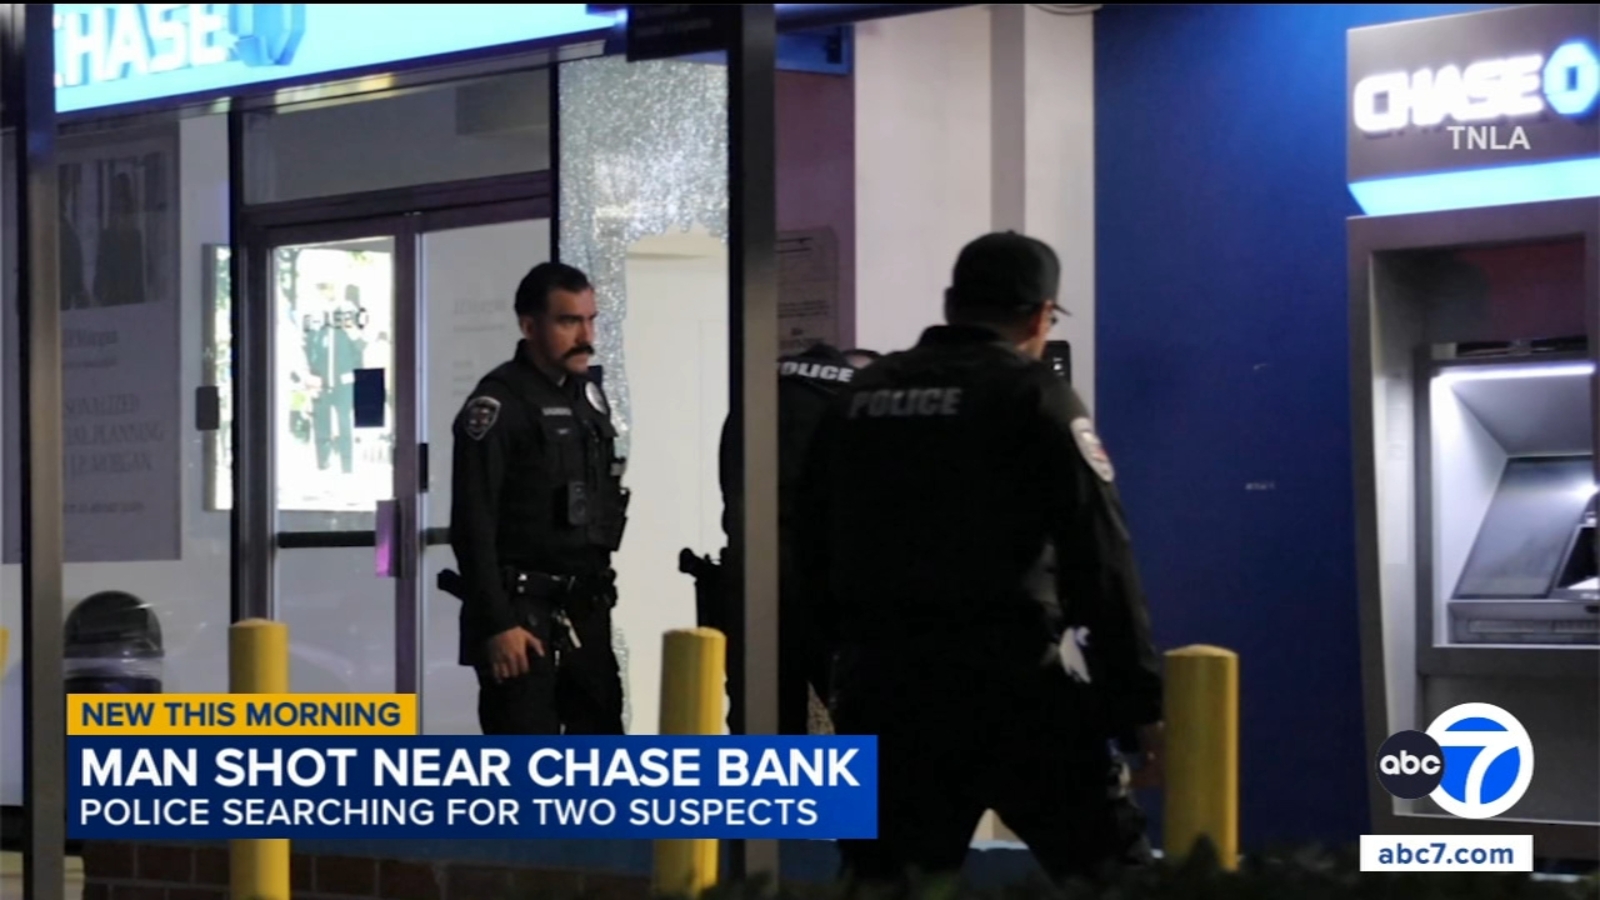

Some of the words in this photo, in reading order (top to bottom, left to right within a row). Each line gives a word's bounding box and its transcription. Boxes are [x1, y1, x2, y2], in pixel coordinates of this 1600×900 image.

[53, 4, 231, 88] HASE
[1354, 54, 1544, 134] CHASE
[777, 360, 855, 383] OLICE
[849, 386, 962, 420] POLICE
